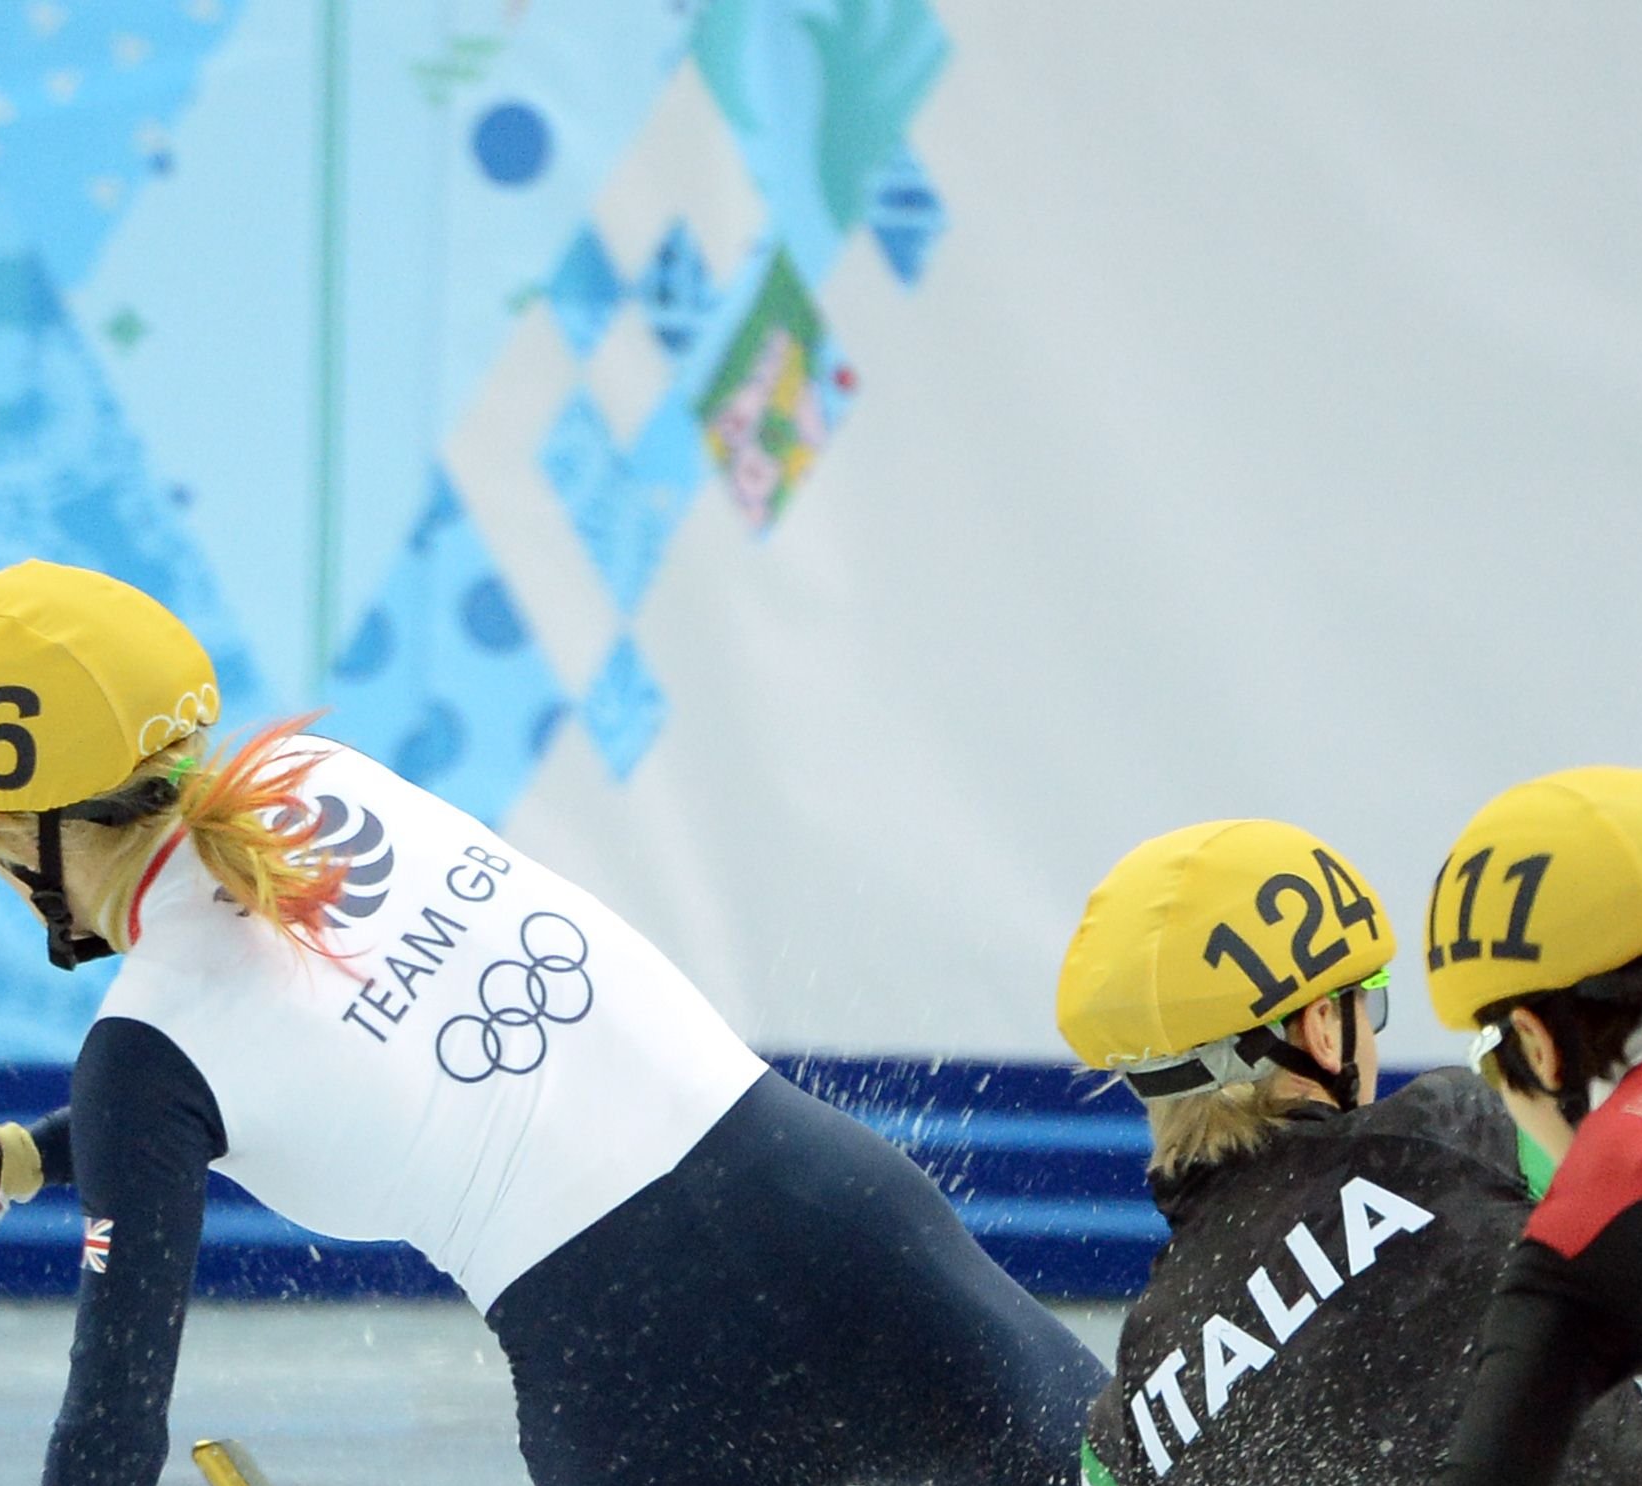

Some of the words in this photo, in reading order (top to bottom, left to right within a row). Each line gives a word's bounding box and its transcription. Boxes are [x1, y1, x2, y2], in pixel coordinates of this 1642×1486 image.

[342, 906, 468, 1043] TEAM
[445, 845, 511, 903] GB
[1203, 848, 1376, 1018] 124
[1428, 847, 1551, 972] 111
[1130, 1176, 1436, 1477] ITALIA
